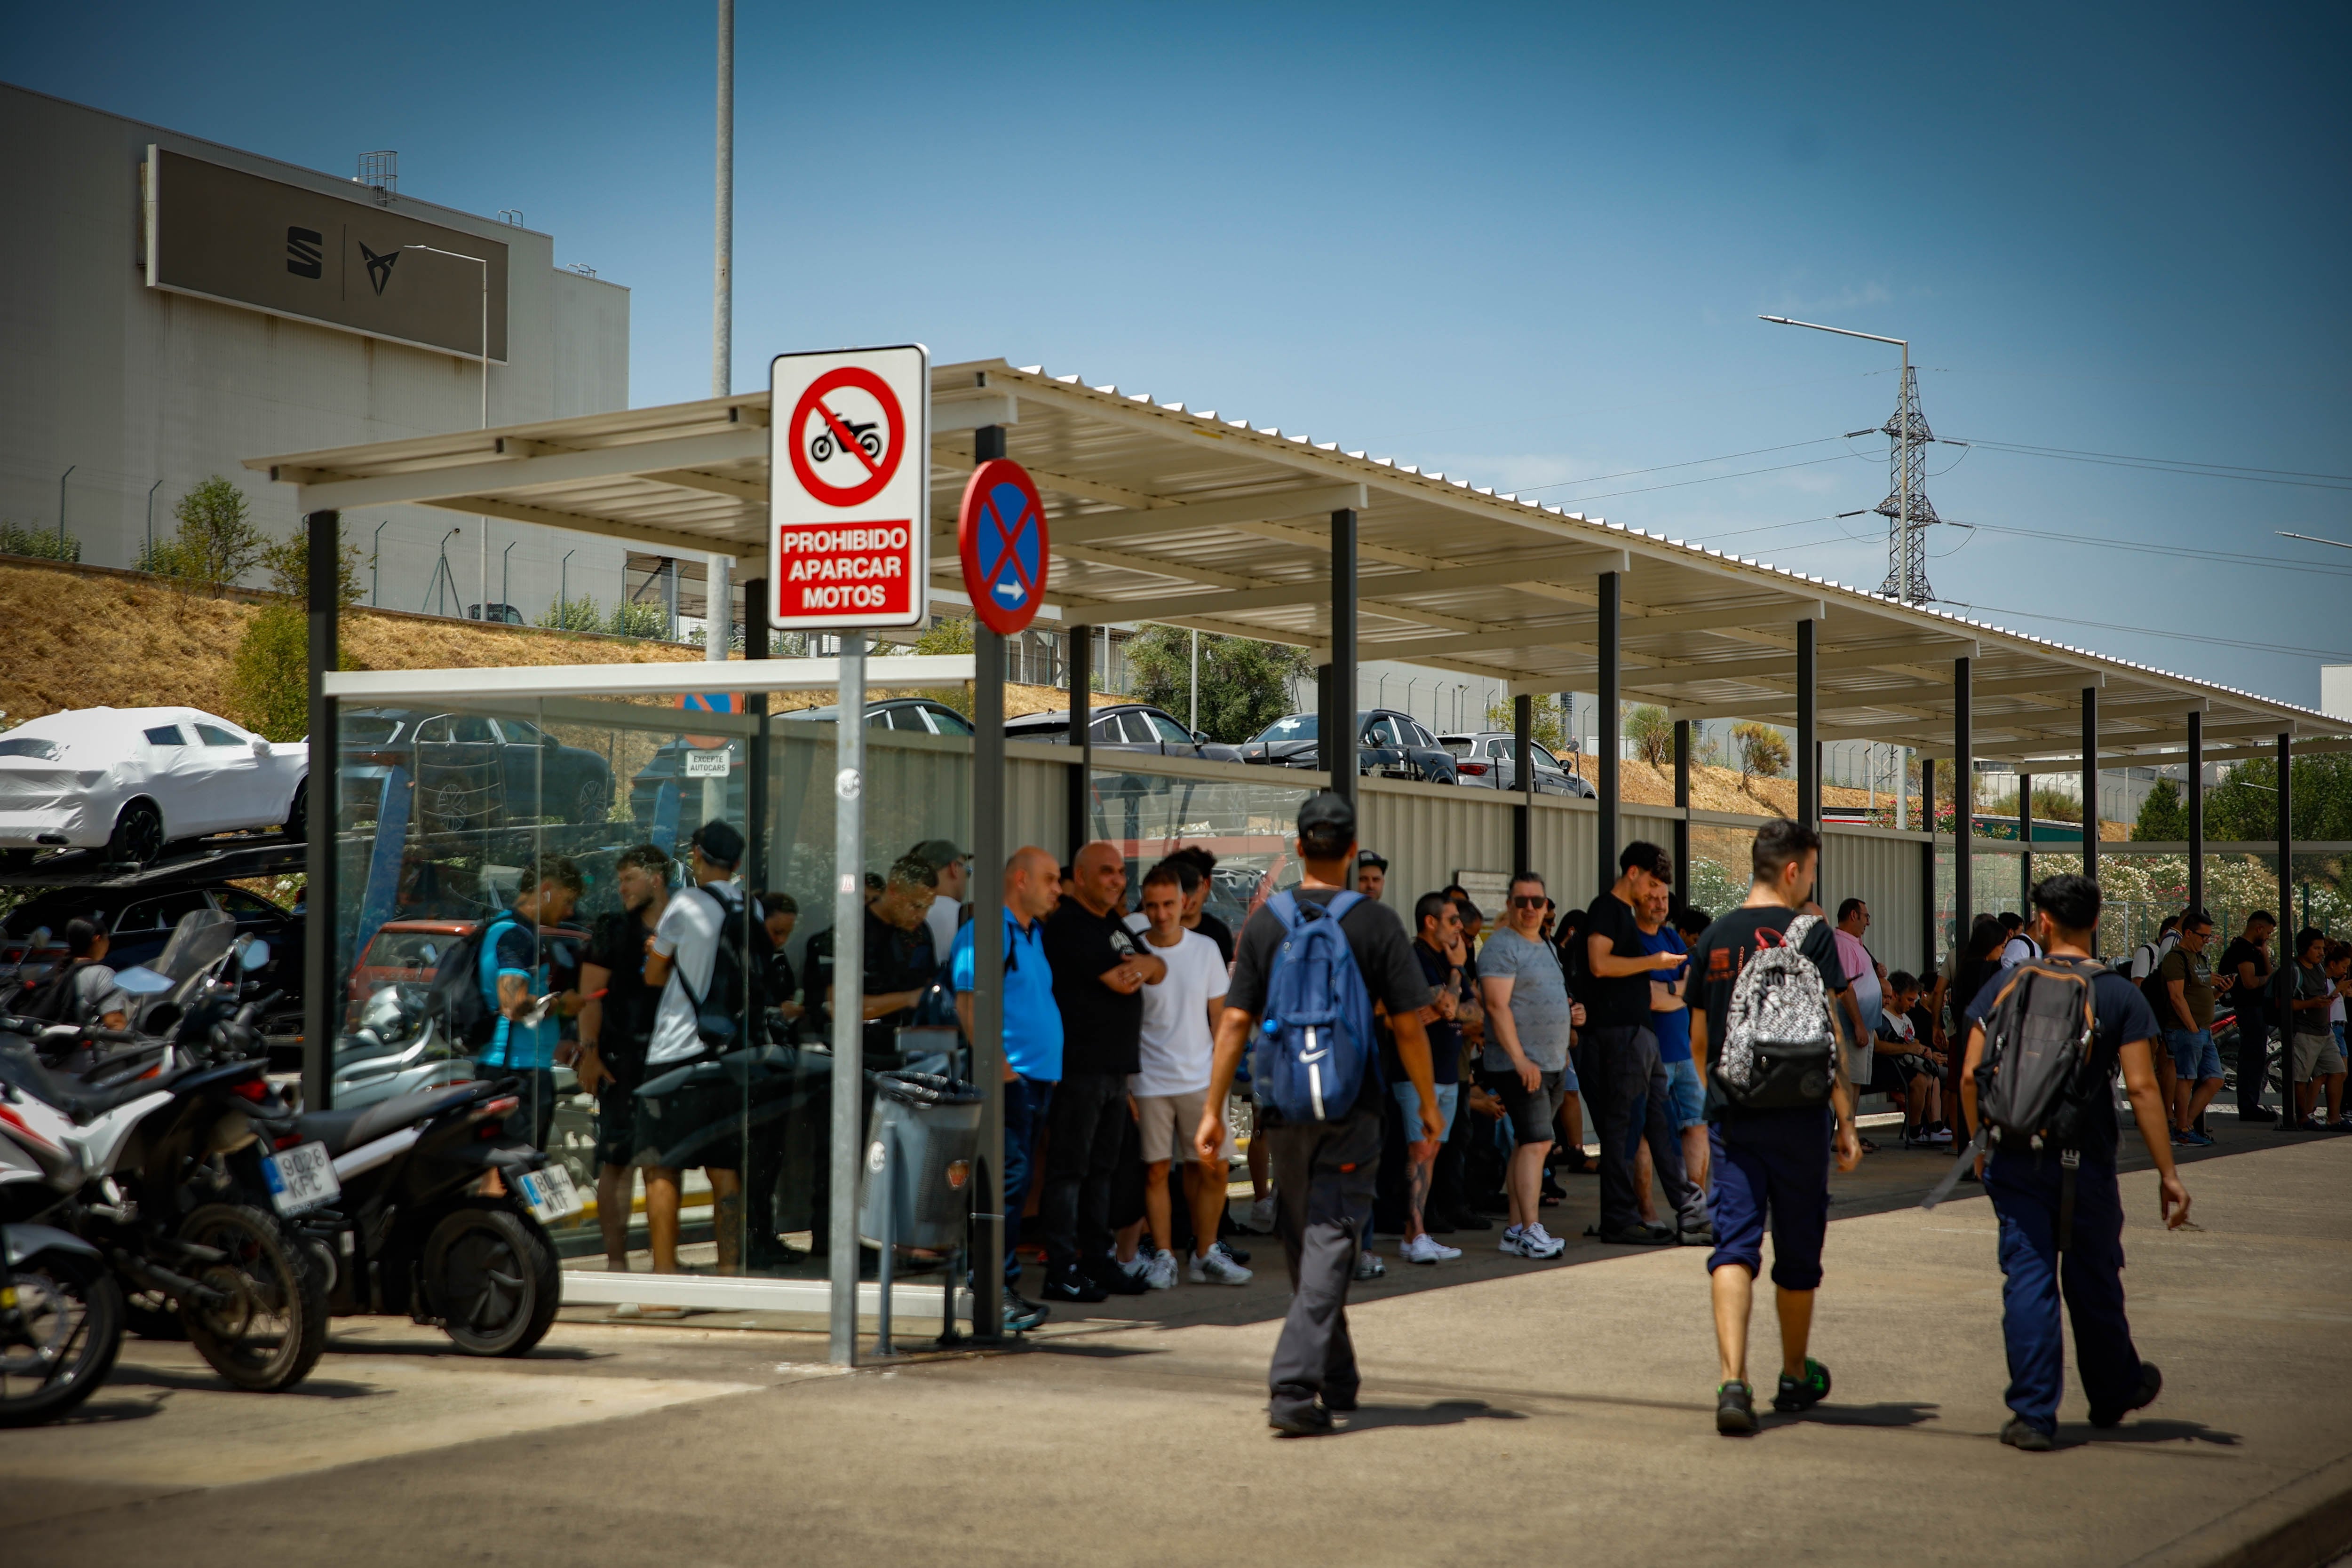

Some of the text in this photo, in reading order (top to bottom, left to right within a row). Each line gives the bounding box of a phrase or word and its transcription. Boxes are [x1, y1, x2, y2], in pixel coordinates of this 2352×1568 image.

[783, 527, 908, 554] PROHIBIDO
[787, 556, 902, 582] APARCAR
[802, 584, 886, 609] MOTOS
[283, 1148, 325, 1177] 9028
[289, 1173, 322, 1198] KFC
[535, 1169, 571, 1193] 8044
